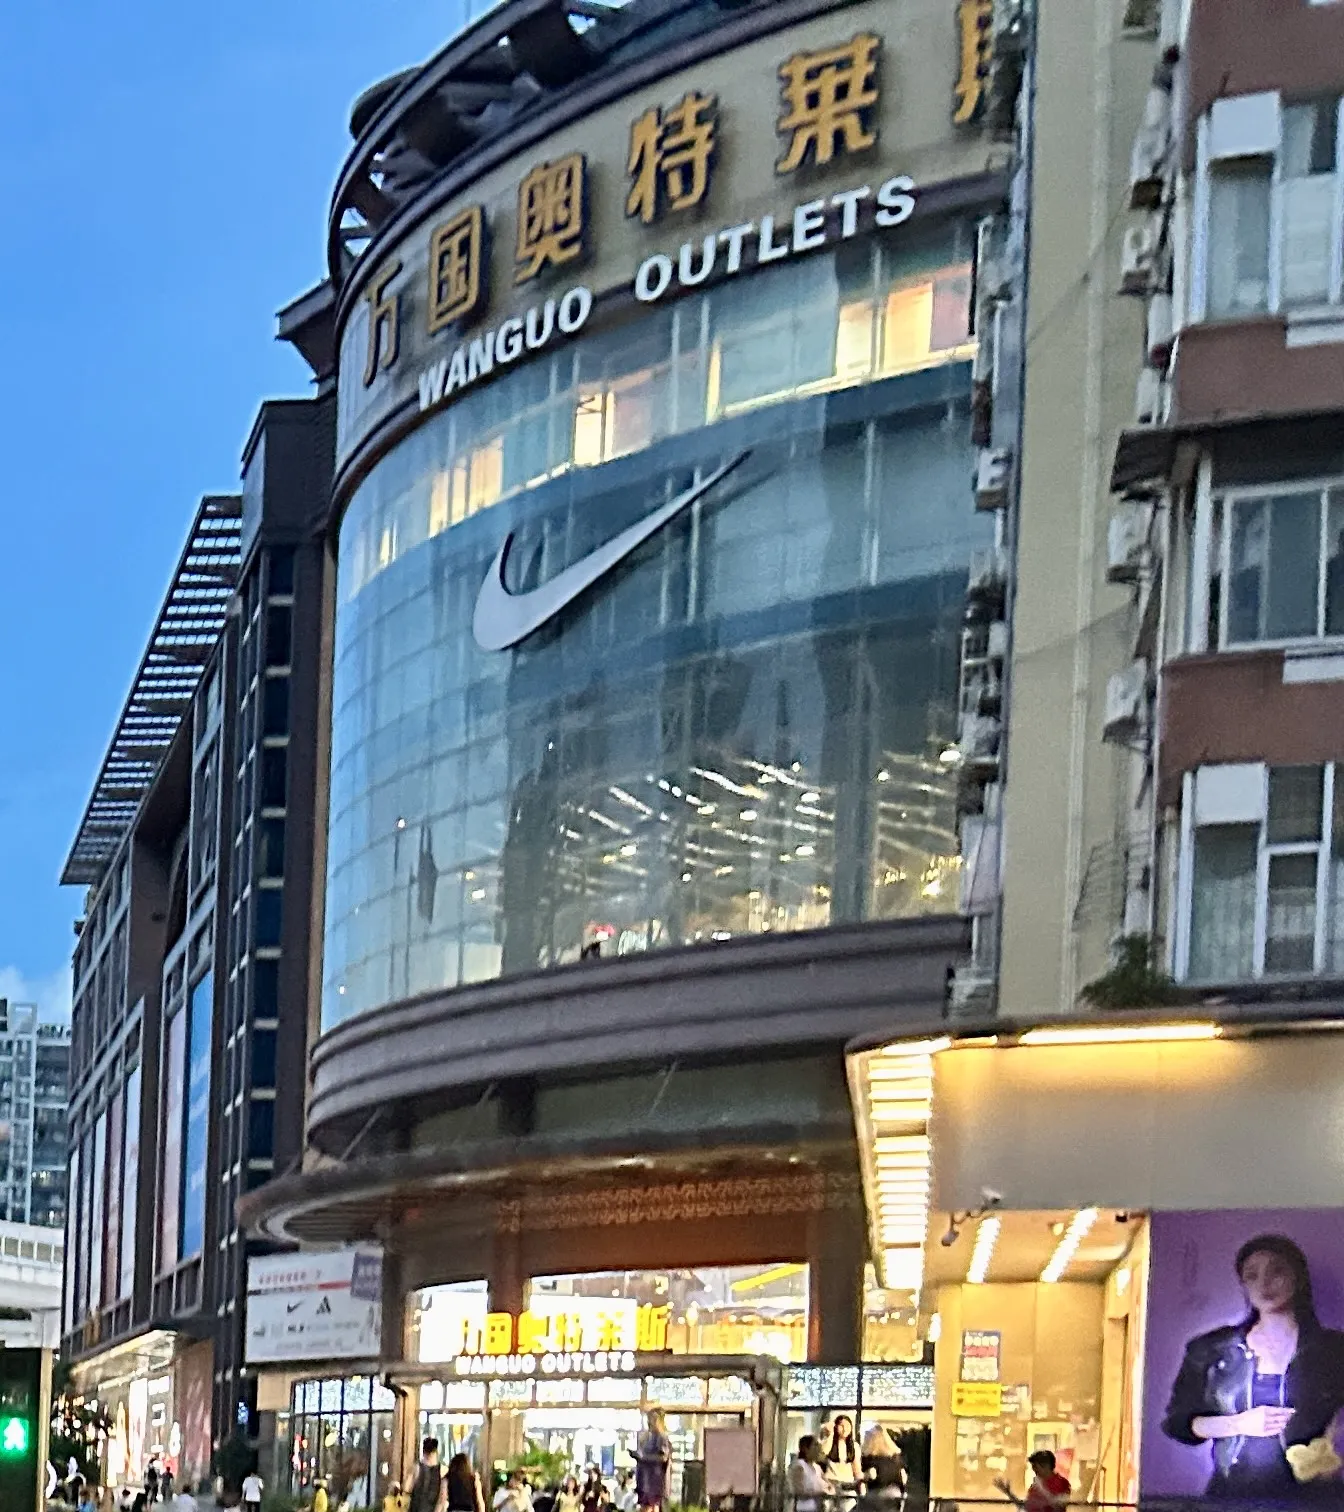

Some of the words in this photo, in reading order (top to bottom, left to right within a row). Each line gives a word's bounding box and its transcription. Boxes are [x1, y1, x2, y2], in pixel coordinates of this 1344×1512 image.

[417, 285, 593, 413] WANGUO
[634, 174, 918, 303] OUTLETS
[455, 1353, 537, 1376] WANGUO
[540, 1351, 637, 1374] OUTLETS
